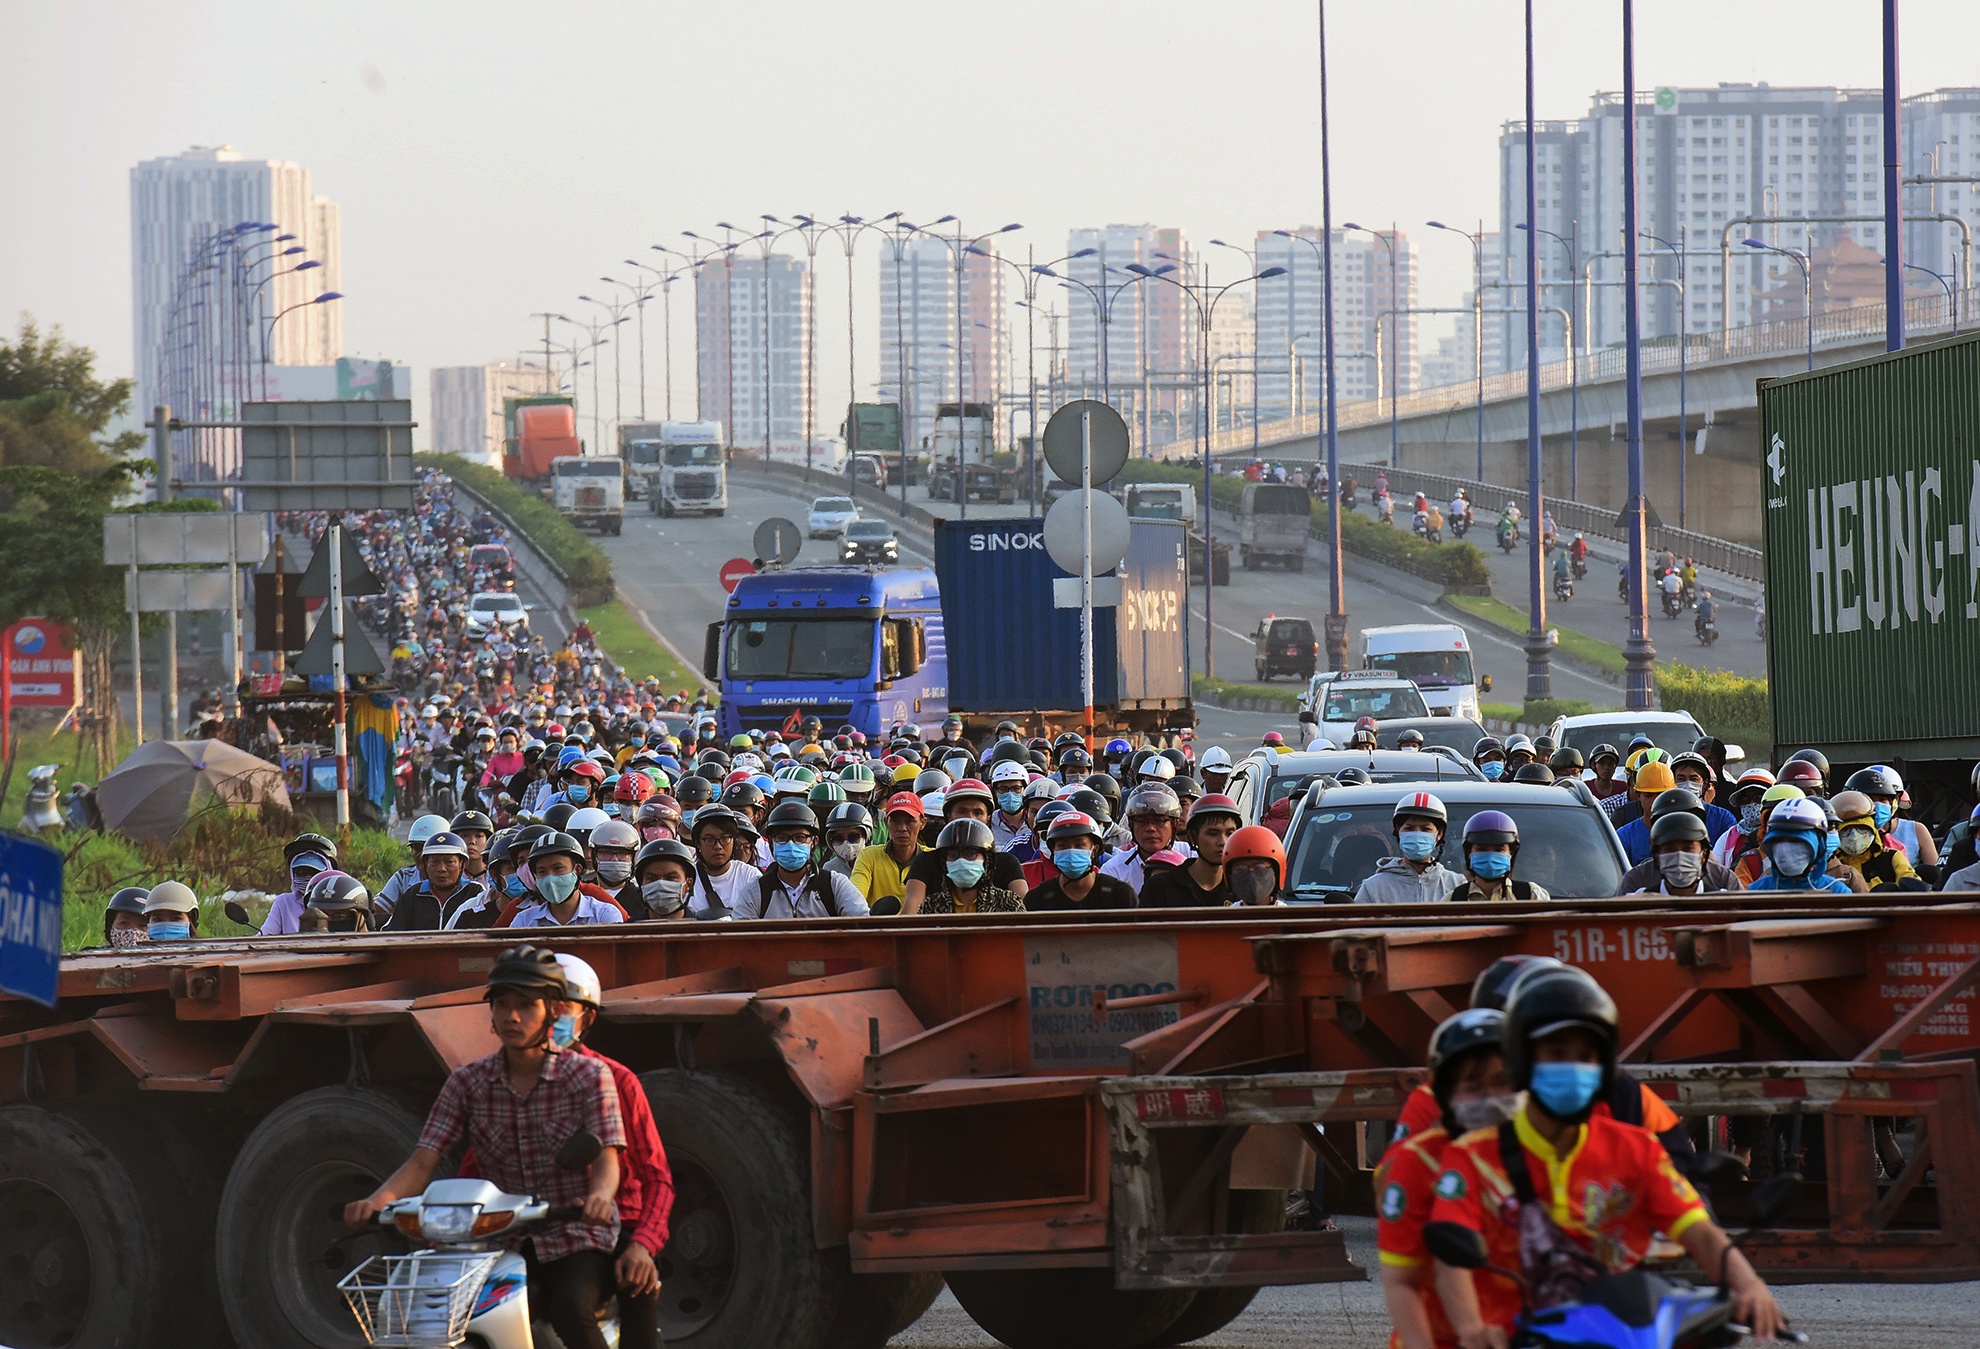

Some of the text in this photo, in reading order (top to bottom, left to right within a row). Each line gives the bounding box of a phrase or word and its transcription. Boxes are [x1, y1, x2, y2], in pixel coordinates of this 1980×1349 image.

[969, 532, 1046, 551] SINOK
[761, 697, 818, 706] SHACMAN
[1552, 926, 1676, 962] 51R-166.
